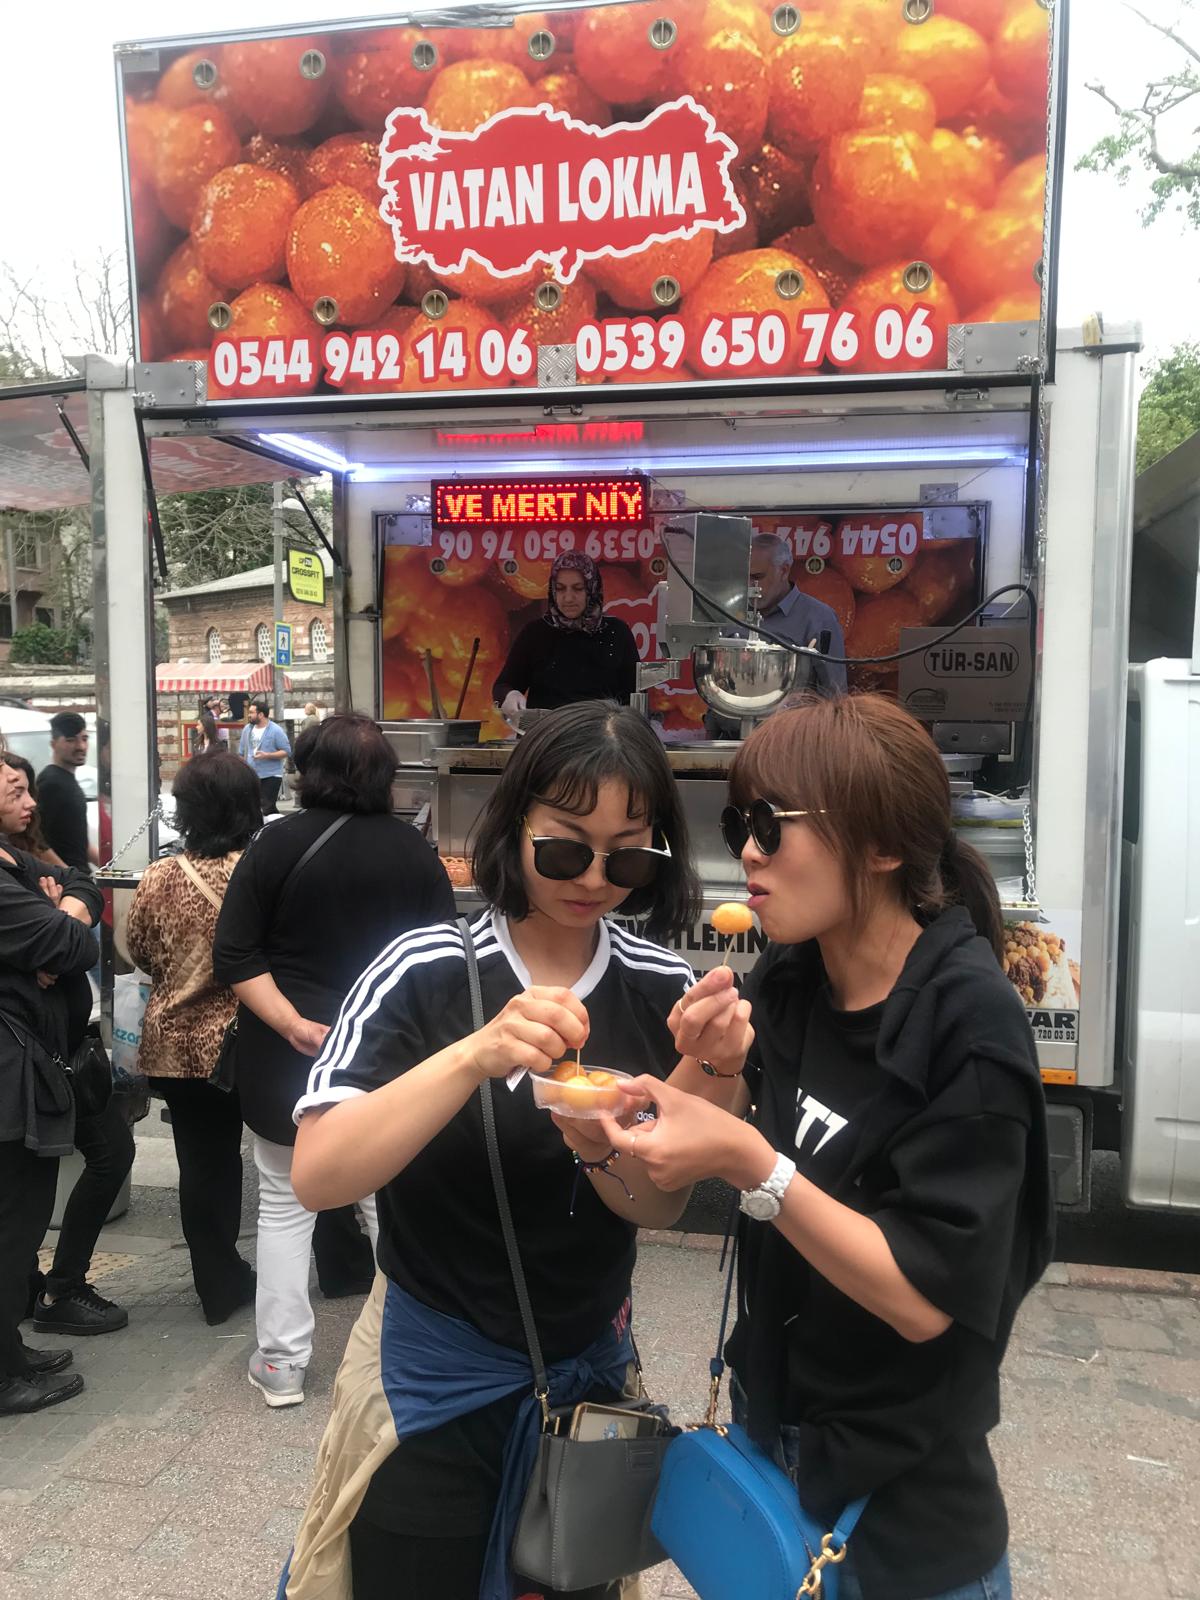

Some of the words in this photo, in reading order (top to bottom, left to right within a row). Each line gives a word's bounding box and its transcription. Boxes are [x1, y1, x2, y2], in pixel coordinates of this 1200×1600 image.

[408, 163, 544, 232] VATAN
[558, 151, 708, 222] LOKMA
[575, 320, 686, 373] 0539
[700, 315, 786, 368] 650
[801, 311, 860, 363] 76
[874, 308, 934, 360] 06
[213, 339, 313, 387] 0544
[325, 334, 401, 382] 942
[415, 332, 466, 378] 14
[479, 328, 533, 376] 06
[444, 494, 483, 518] VE
[492, 492, 577, 517] MERT
[438, 530, 473, 561] 06
[481, 531, 518, 562] 76
[523, 530, 576, 562] 650
[584, 529, 655, 560] 0539
[840, 523, 918, 556] 0544
[929, 648, 1014, 672] TÜR-SAN
